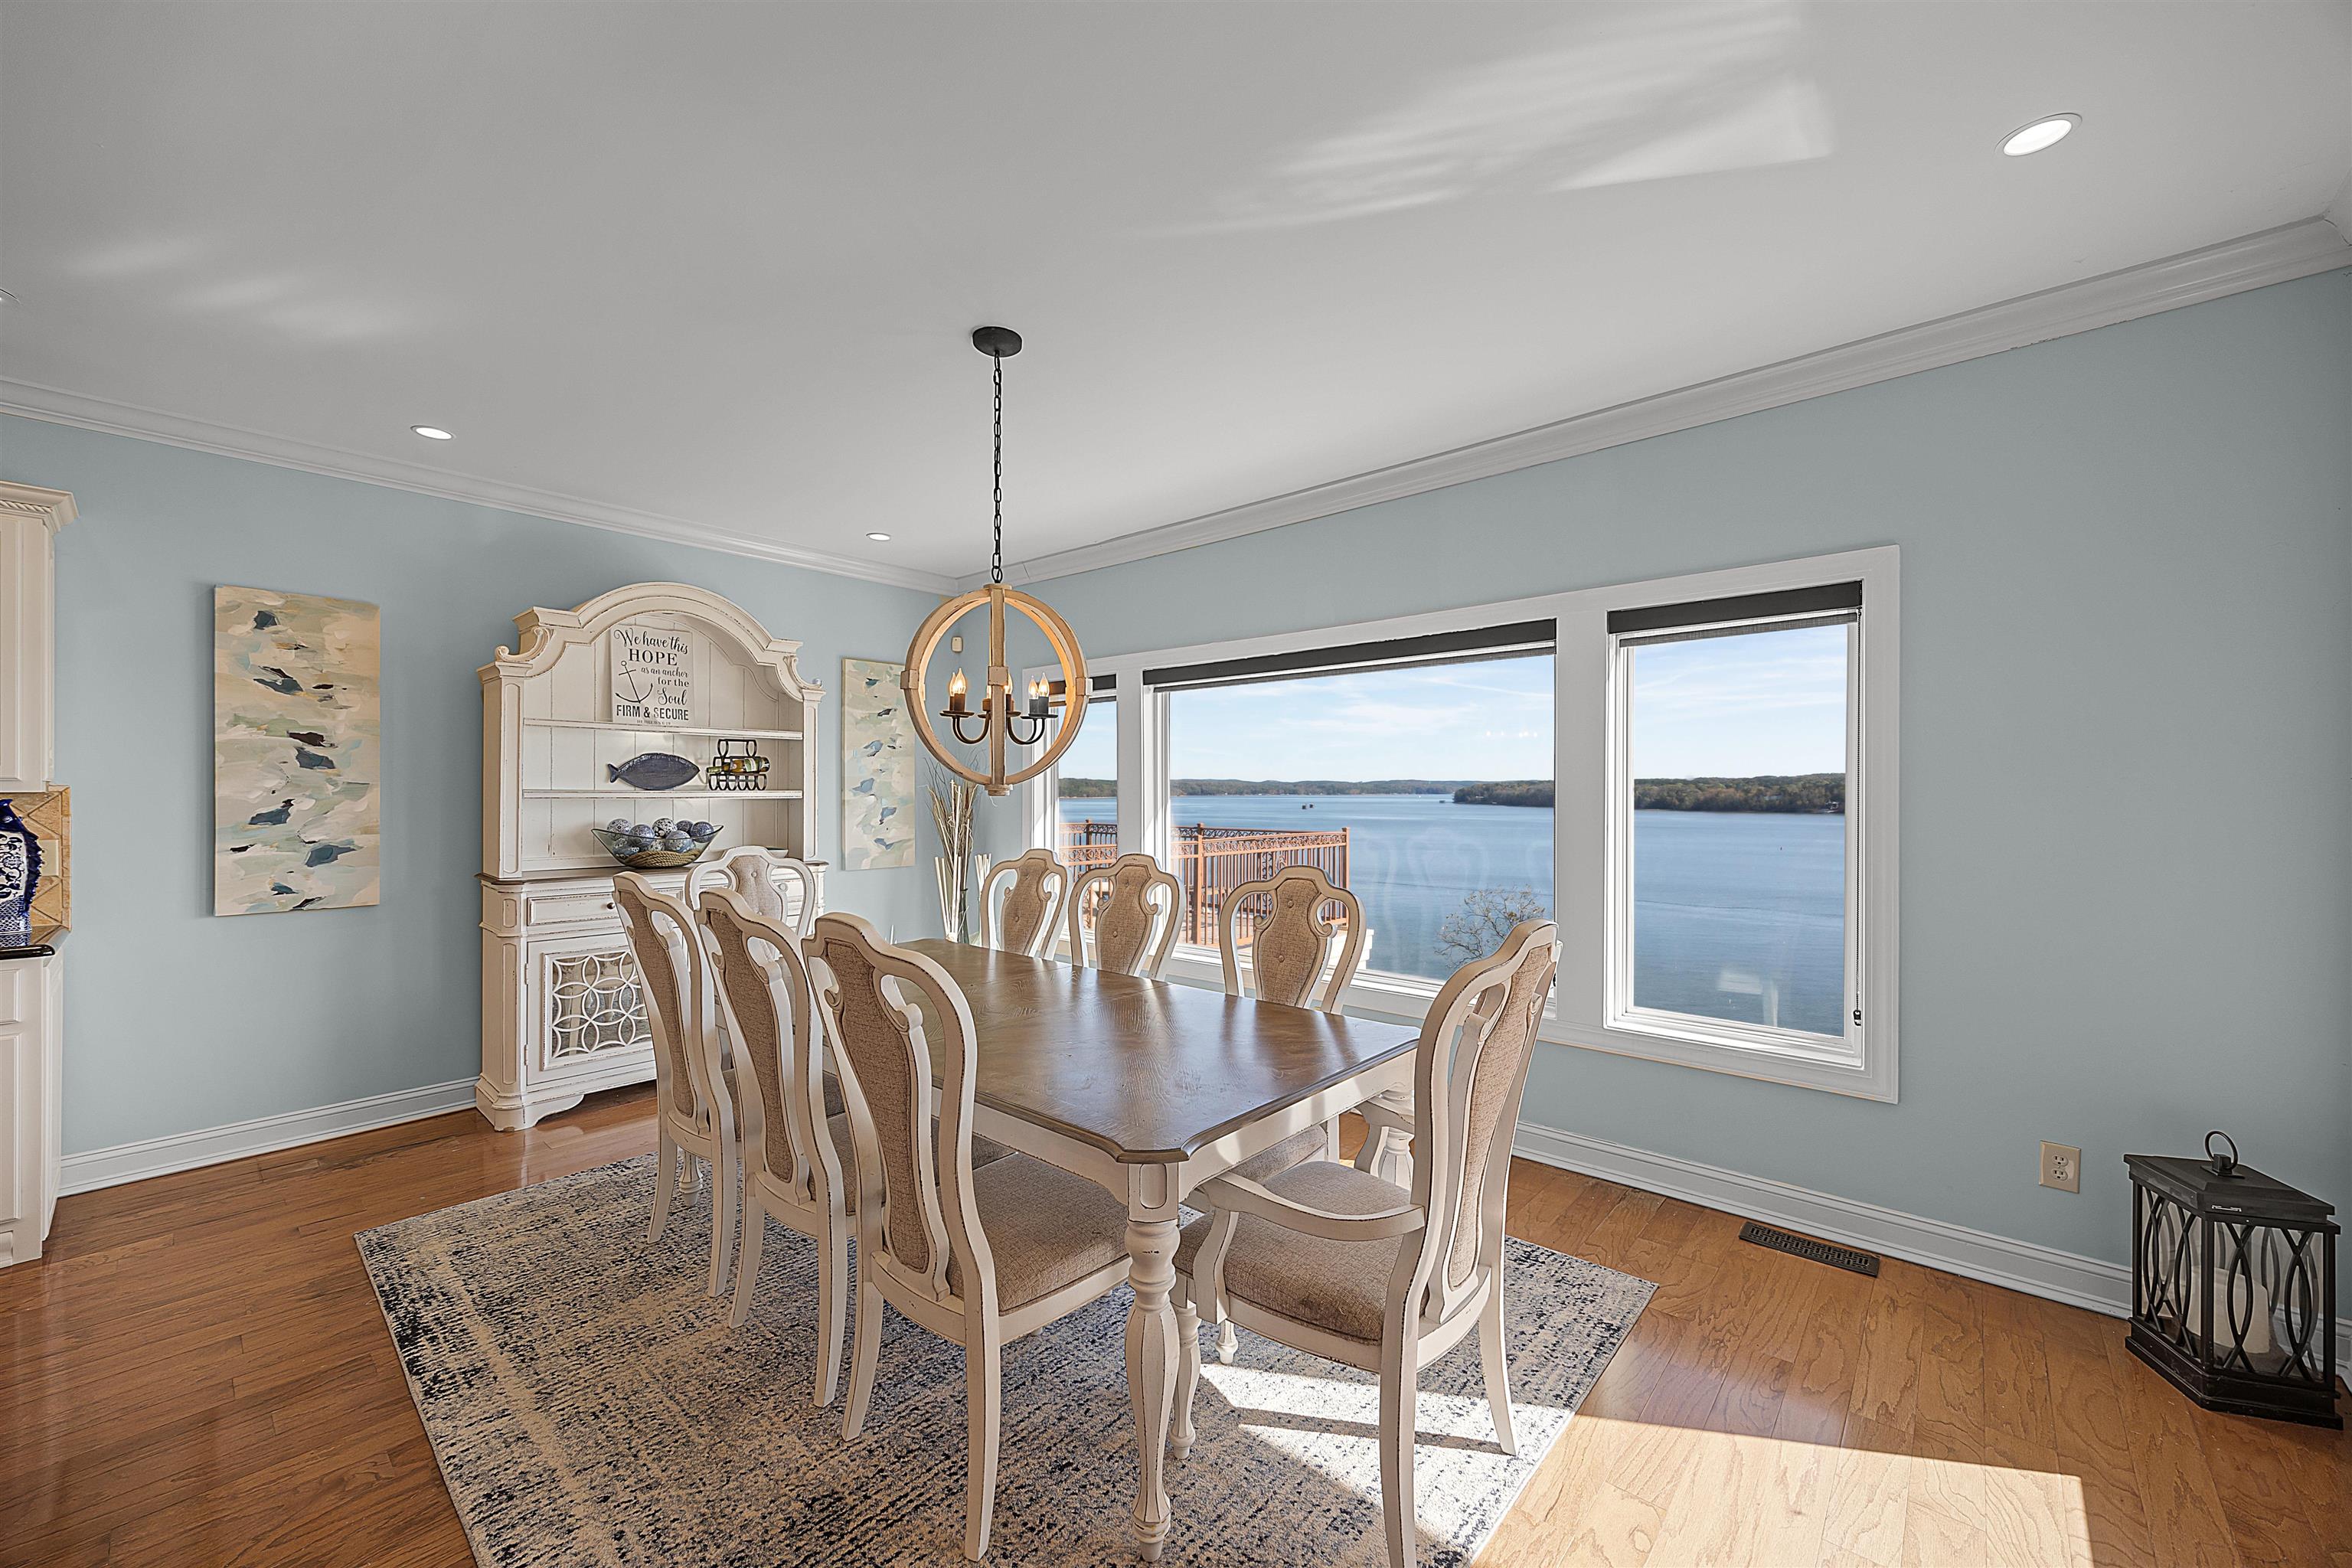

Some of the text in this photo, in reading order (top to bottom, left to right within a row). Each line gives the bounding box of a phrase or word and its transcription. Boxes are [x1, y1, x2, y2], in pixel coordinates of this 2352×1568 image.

[614, 628, 688, 655] We have this
[629, 648, 678, 666] HOPE
[662, 667, 688, 678] anchor
[658, 677, 689, 687] for the
[657, 688, 687, 705] Soul
[616, 704, 689, 720] FIRM & SECURE
